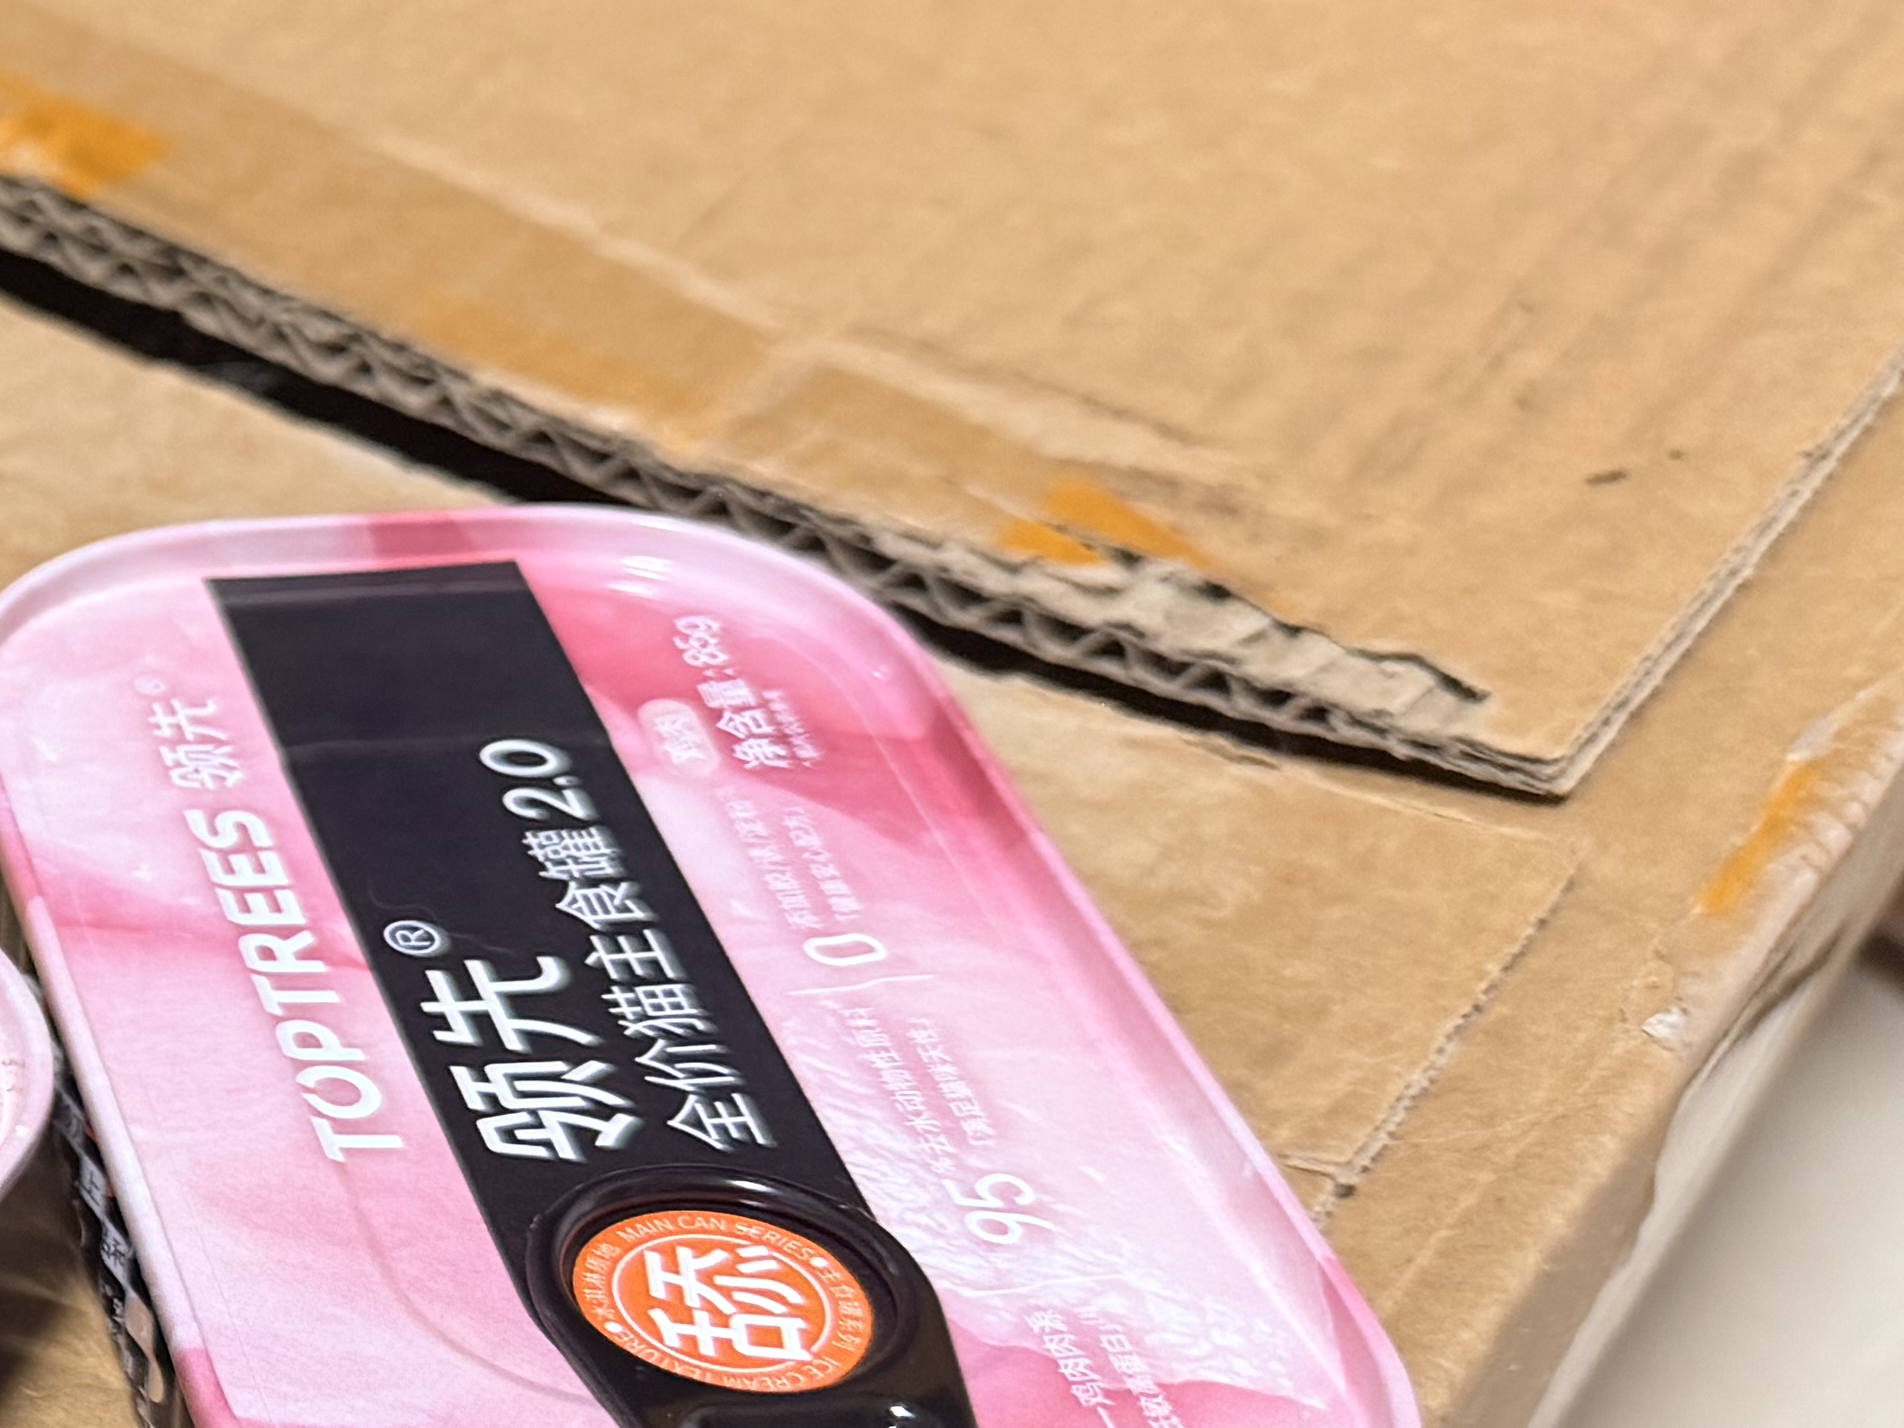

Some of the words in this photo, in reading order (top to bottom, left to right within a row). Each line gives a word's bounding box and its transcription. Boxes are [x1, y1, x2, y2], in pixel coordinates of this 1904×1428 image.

[472, 738, 599, 820] 2.0
[185, 810, 405, 1162] TOPTREES
[519, 828, 775, 1152] 全价猫主食罐
[617, 1219, 673, 1243] MAIN
[677, 1215, 725, 1231] CAN
[734, 1221, 812, 1260] SERIES
[644, 1245, 813, 1361] 舔
